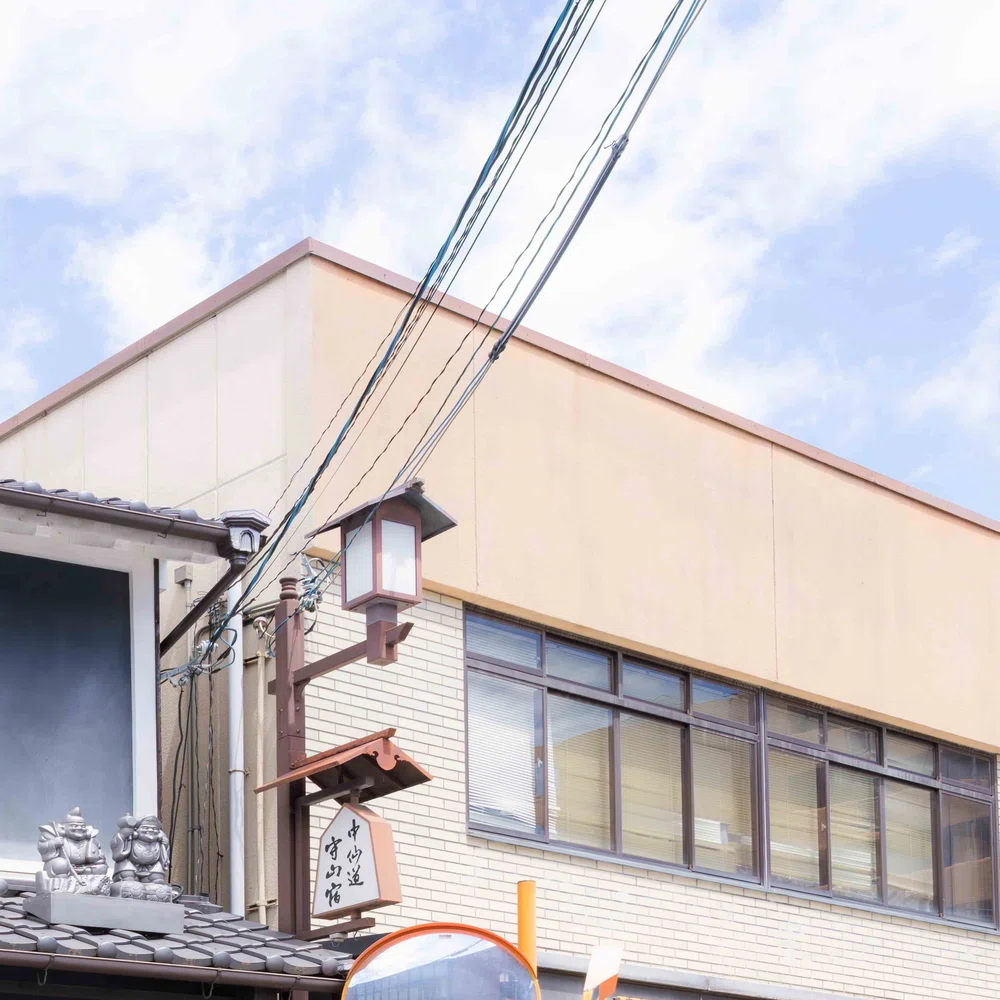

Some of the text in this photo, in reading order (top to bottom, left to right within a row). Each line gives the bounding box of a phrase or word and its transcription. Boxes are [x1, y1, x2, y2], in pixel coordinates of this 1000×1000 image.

[324, 836, 342, 908] 守山宿
[346, 818, 364, 887] 中仙道
